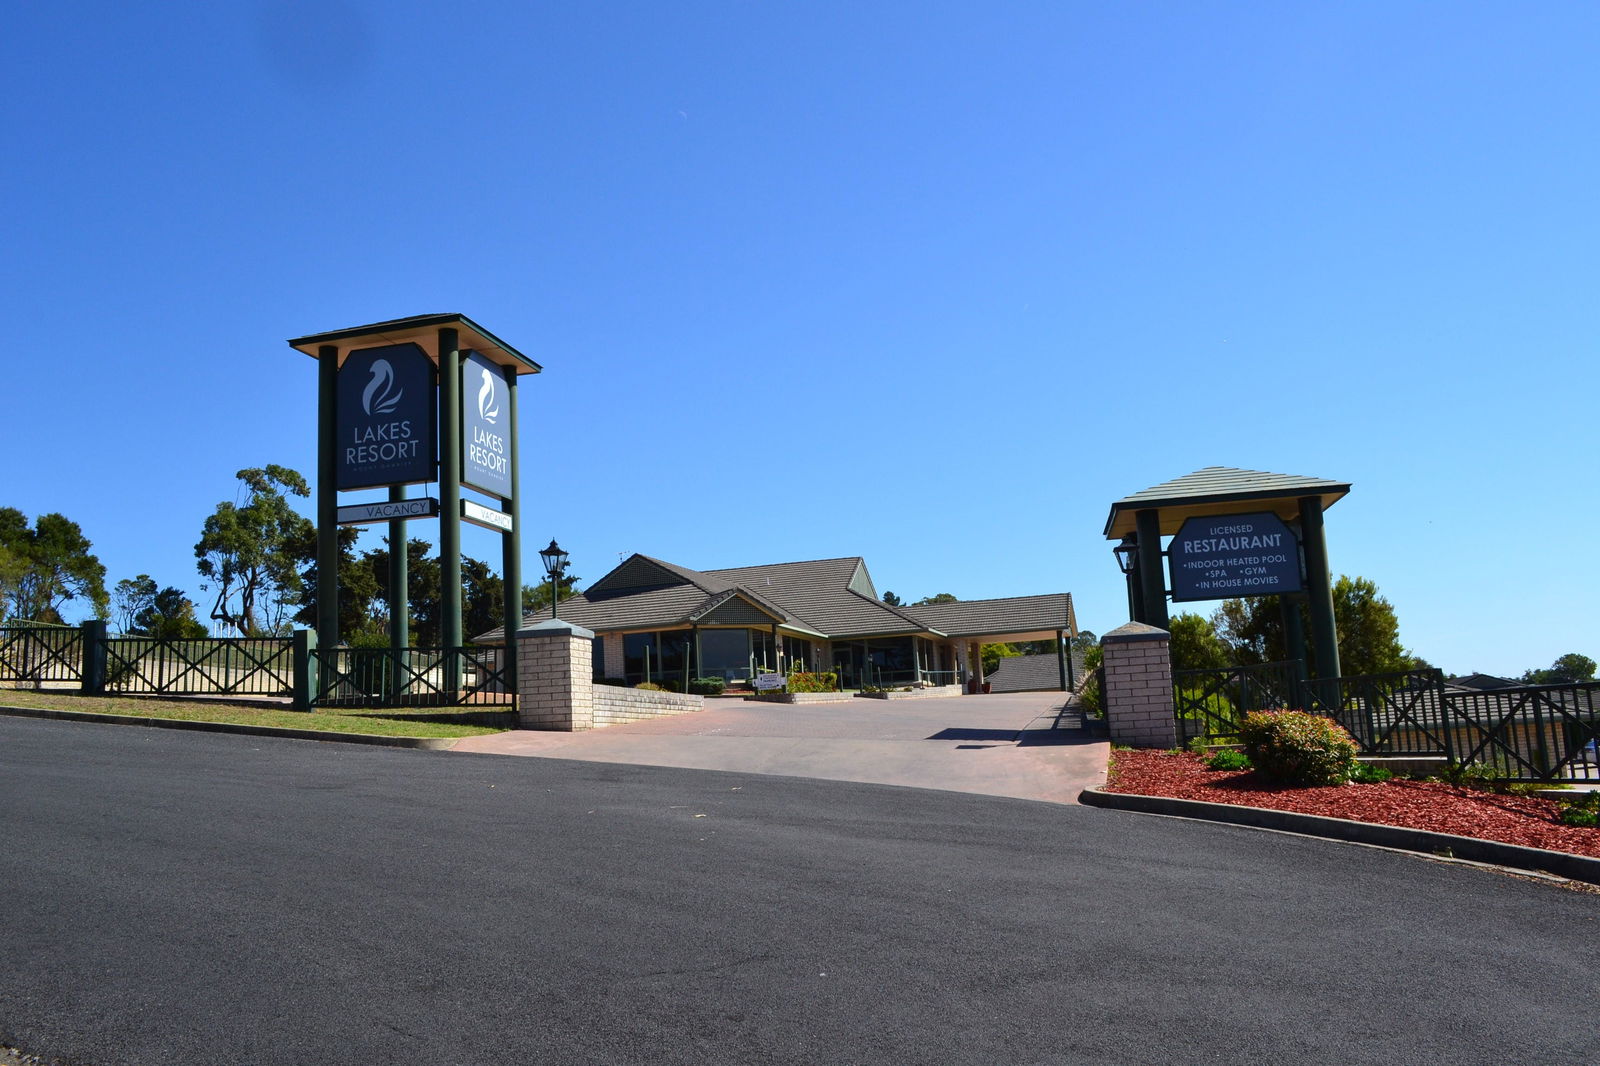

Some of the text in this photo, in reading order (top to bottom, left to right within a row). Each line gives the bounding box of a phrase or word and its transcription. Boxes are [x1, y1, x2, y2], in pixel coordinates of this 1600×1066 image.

[354, 420, 411, 444] LAKES
[474, 425, 503, 454] LAKES
[346, 440, 419, 465] RESORT
[470, 443, 507, 474] RESORT
[366, 502, 426, 518] VACANCY
[481, 508, 511, 526] VACANCY
[1210, 524, 1253, 535] LICENSED
[1184, 533, 1281, 554] RESTAURANT
[1227, 556, 1260, 567] HEATED
[1262, 554, 1287, 564] POOL
[1212, 578, 1241, 588] HOUSE
[1244, 575, 1279, 586] MOVIES
